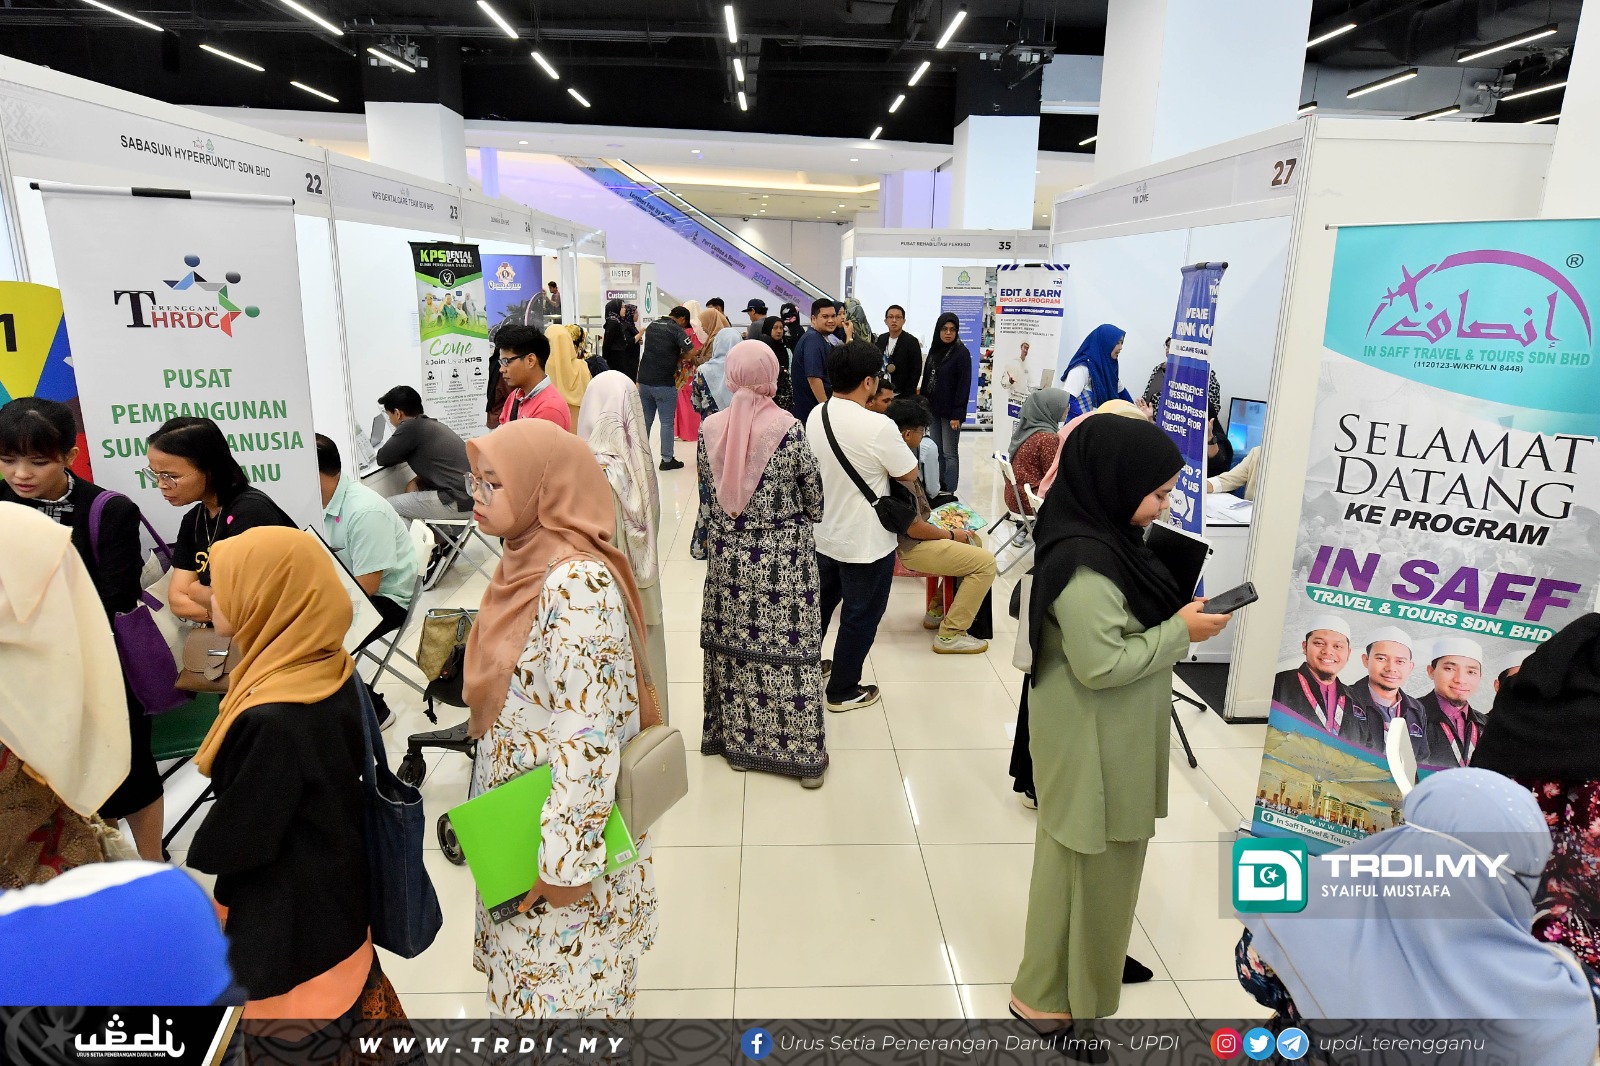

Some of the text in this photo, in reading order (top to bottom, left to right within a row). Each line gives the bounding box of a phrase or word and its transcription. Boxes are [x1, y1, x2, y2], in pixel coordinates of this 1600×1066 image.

[120, 134, 271, 178] SABASUN HYPERRUNCIT SDN BHD
[1271, 157, 1297, 187] 27
[305, 173, 323, 195] 22
[450, 205, 458, 220] 23
[420, 249, 473, 263] KPS DENTAL
[998, 241, 1012, 250] 35
[607, 291, 636, 299] Customise
[1000, 288, 1062, 299] EDIT & EARN
[429, 338, 473, 357] Come
[1363, 345, 1591, 366] IN SAFF TRAVEL & TOURS SDN BHD
[464, 356, 482, 364] KPS
[1413, 360, 1524, 374] (1120123-W/KPK/LN 8448)
[162, 368, 232, 389] PUSAT
[110, 399, 287, 424] PEMBANGUNAN
[1333, 412, 1595, 475] SELAMAT
[1333, 454, 1575, 520] DATANG
[1343, 502, 1550, 547] KE PROGRAM
[1306, 544, 1582, 623] IN SAFF
[1312, 588, 1553, 644] TRAVEL & TOURS SDN. BHD
[1285, 819, 1301, 831] Saff
[1299, 824, 1323, 838] Travel
[1323, 831, 1330, 840] &
[1330, 834, 1351, 846] Tours
